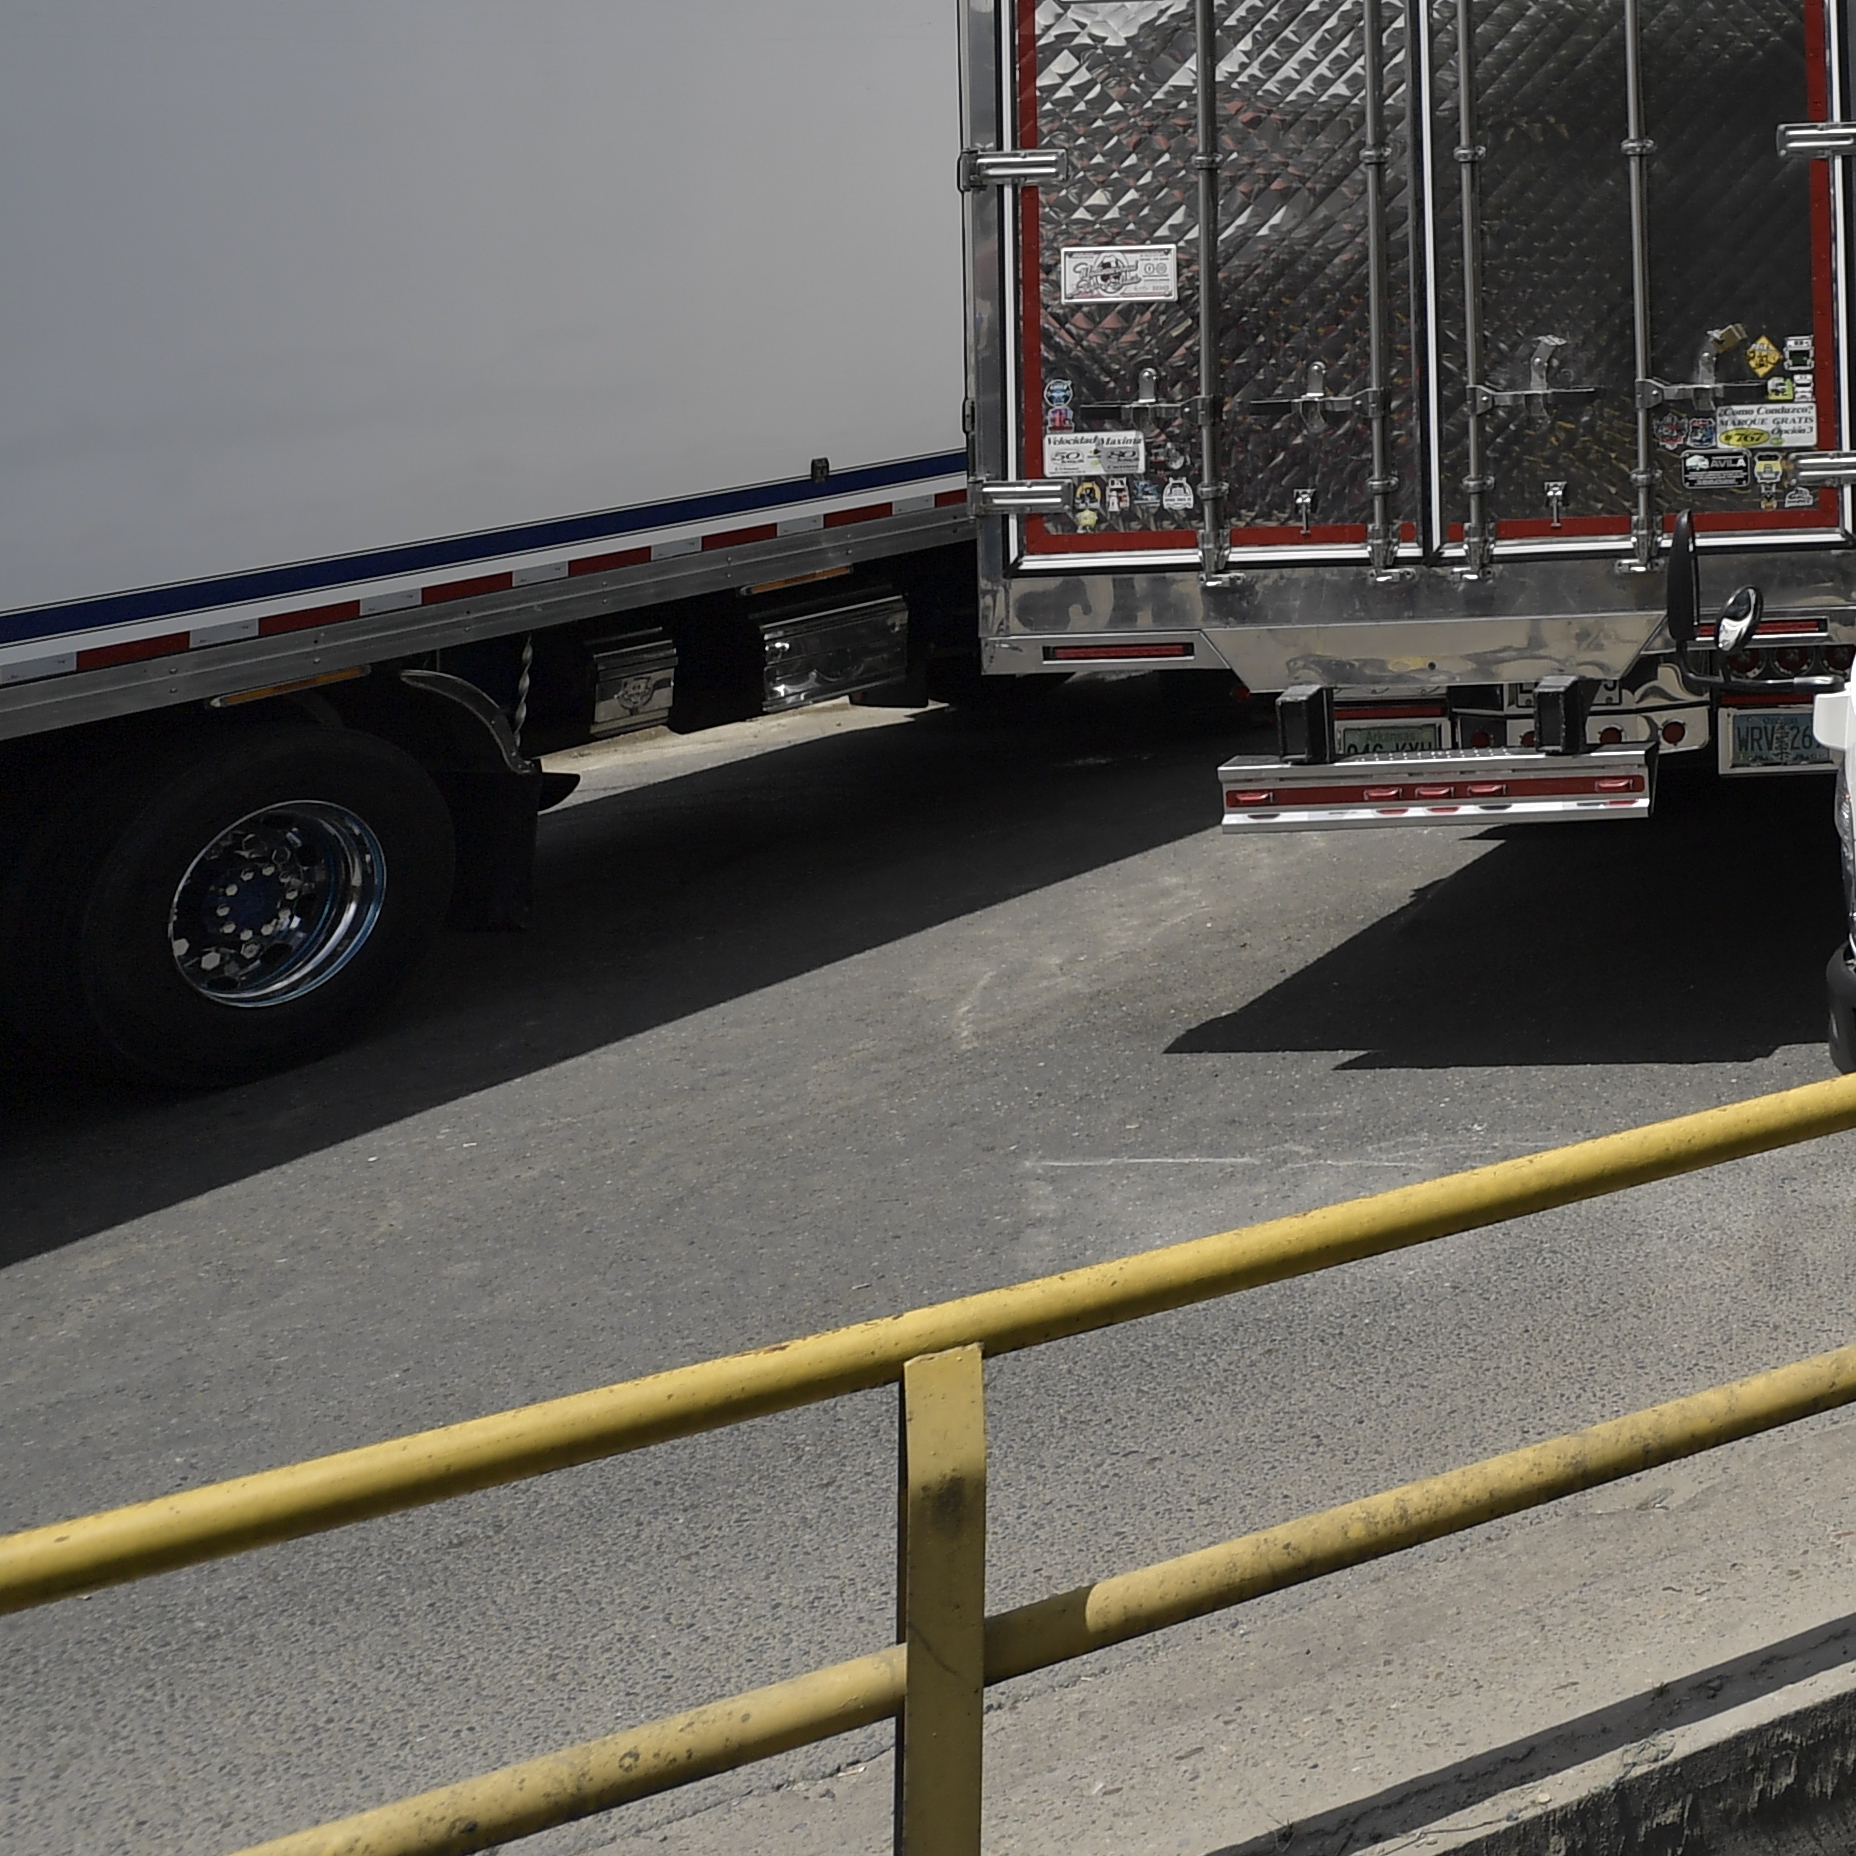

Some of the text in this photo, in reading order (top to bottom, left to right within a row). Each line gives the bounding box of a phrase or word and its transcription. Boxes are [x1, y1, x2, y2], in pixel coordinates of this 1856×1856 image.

[1772, 417, 1814, 425] GRATIS
[1710, 458, 1746, 468] AVILA
[1737, 726, 1776, 751] WRV
